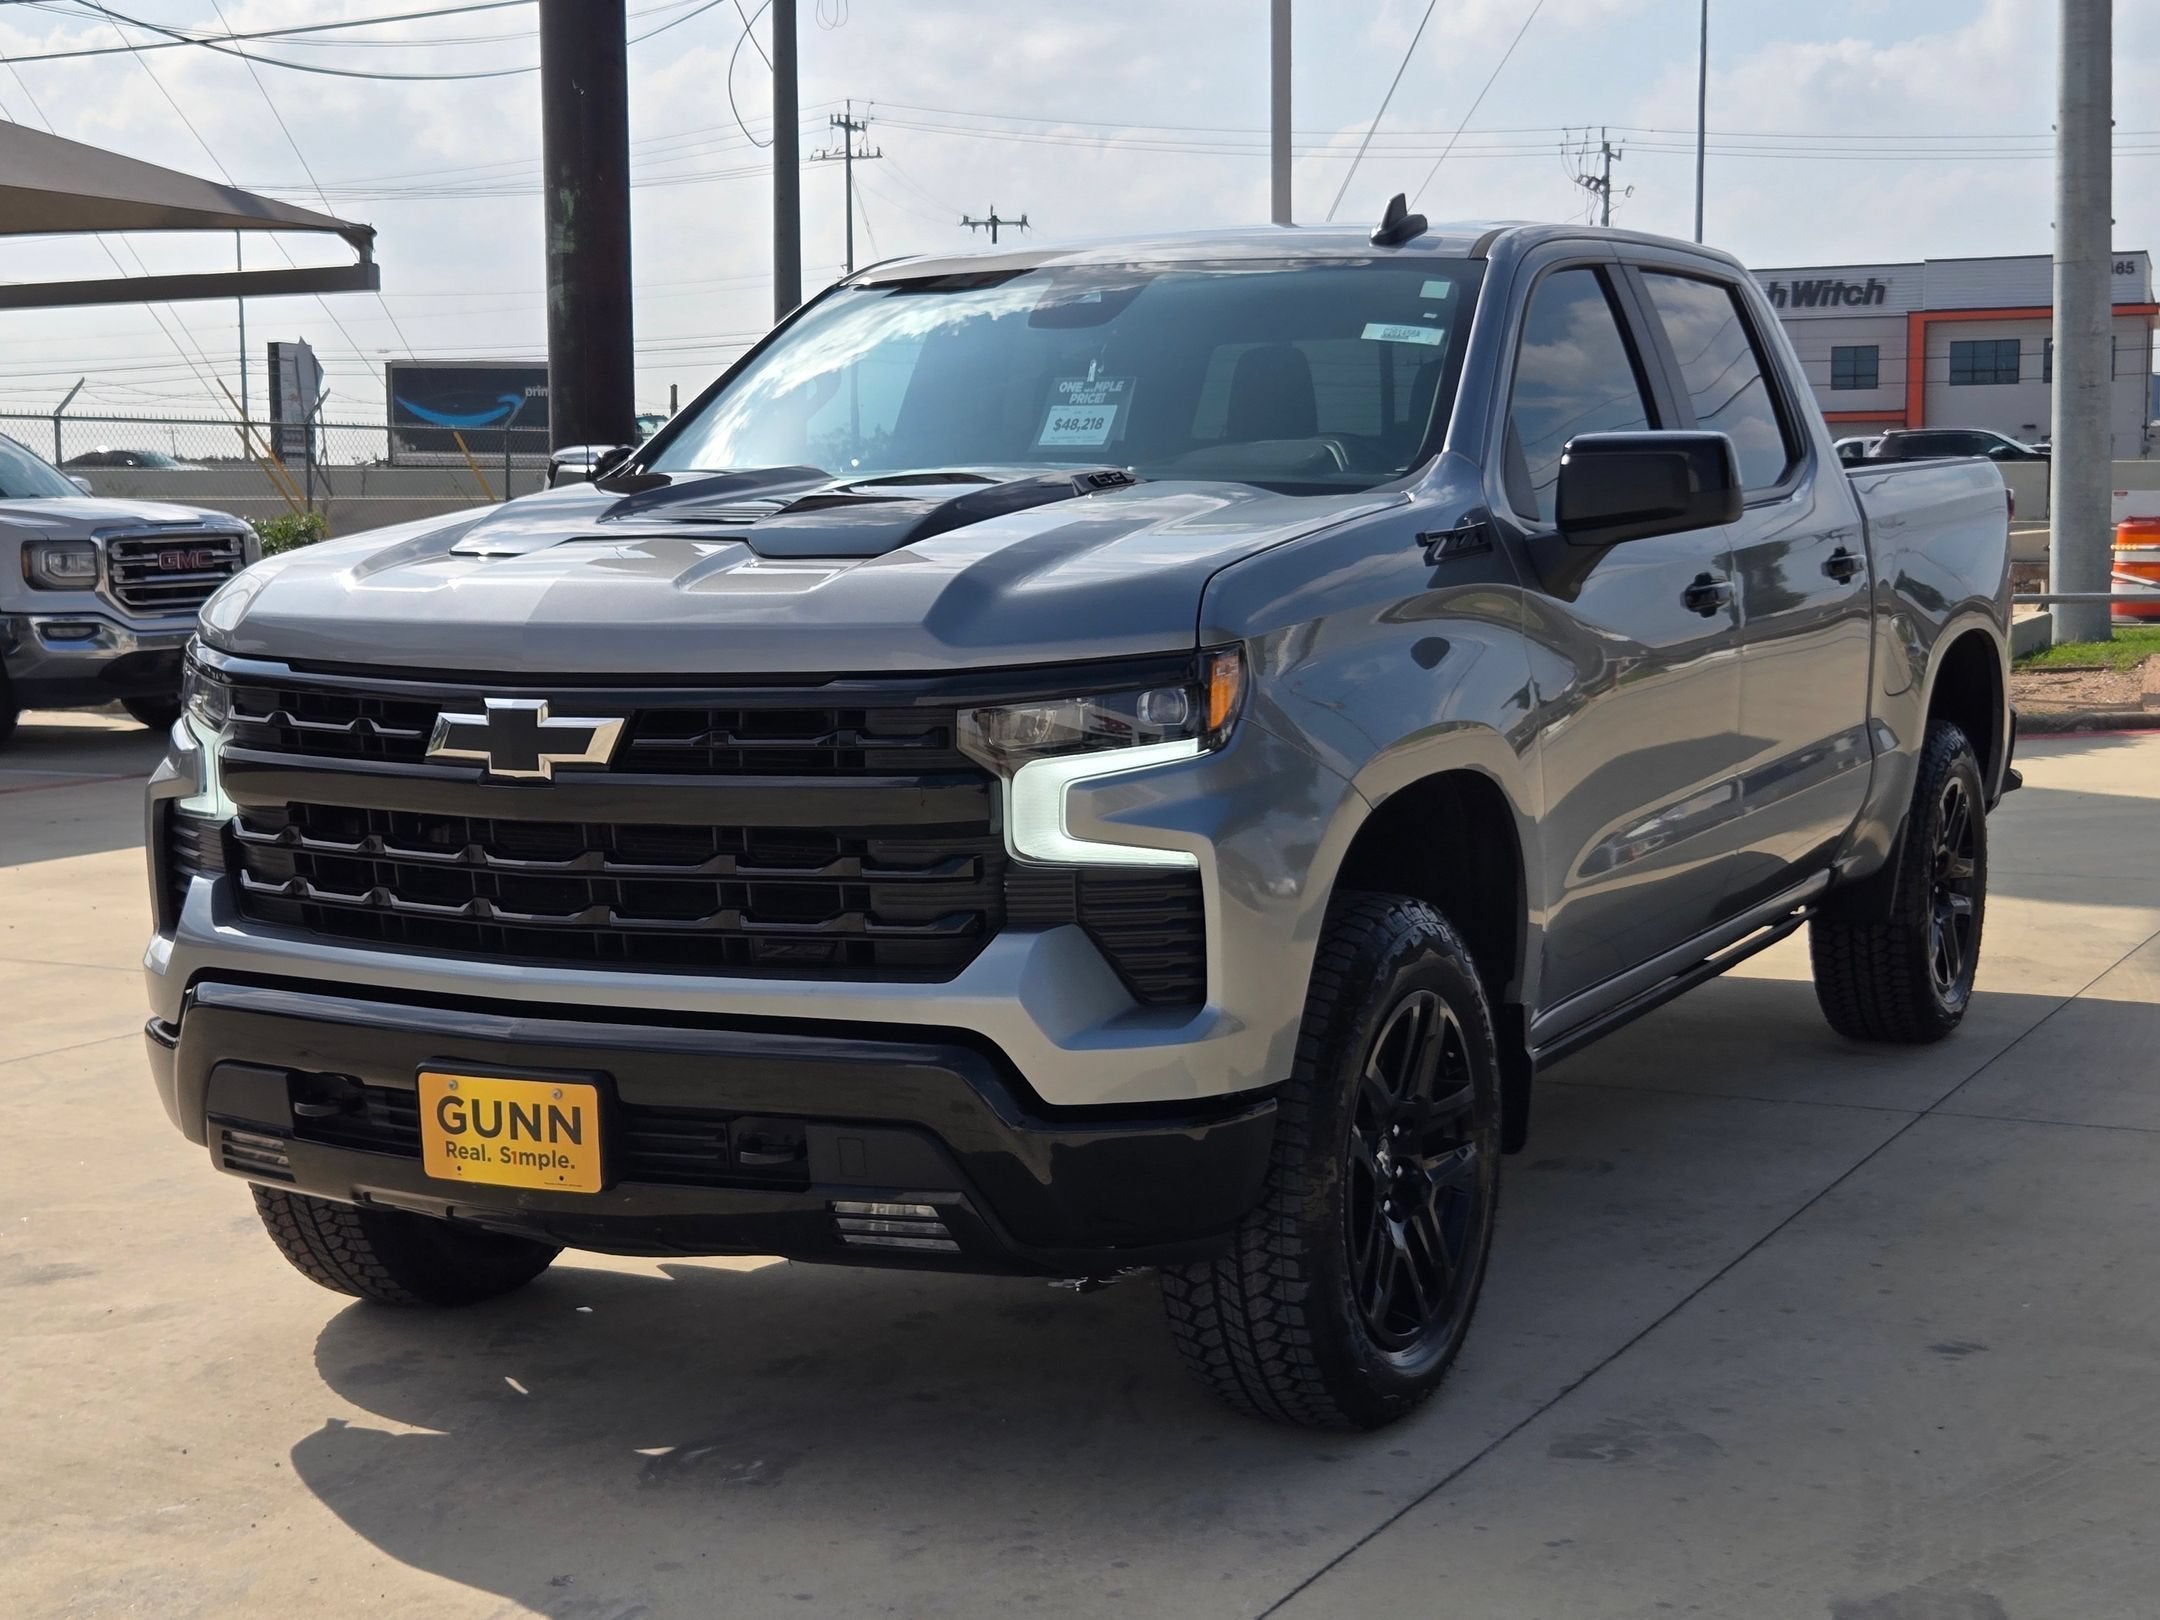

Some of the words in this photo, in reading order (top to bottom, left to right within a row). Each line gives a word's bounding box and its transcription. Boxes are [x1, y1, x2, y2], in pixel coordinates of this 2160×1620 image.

[1790, 277, 1886, 308] Witch
[1058, 381, 1084, 393] ONE
[1084, 380, 1124, 393] MPLE
[1053, 417, 1104, 432] $48,218
[159, 550, 214, 570] GMC
[436, 1095, 582, 1145] GUNN
[445, 1141, 491, 1162] Real.
